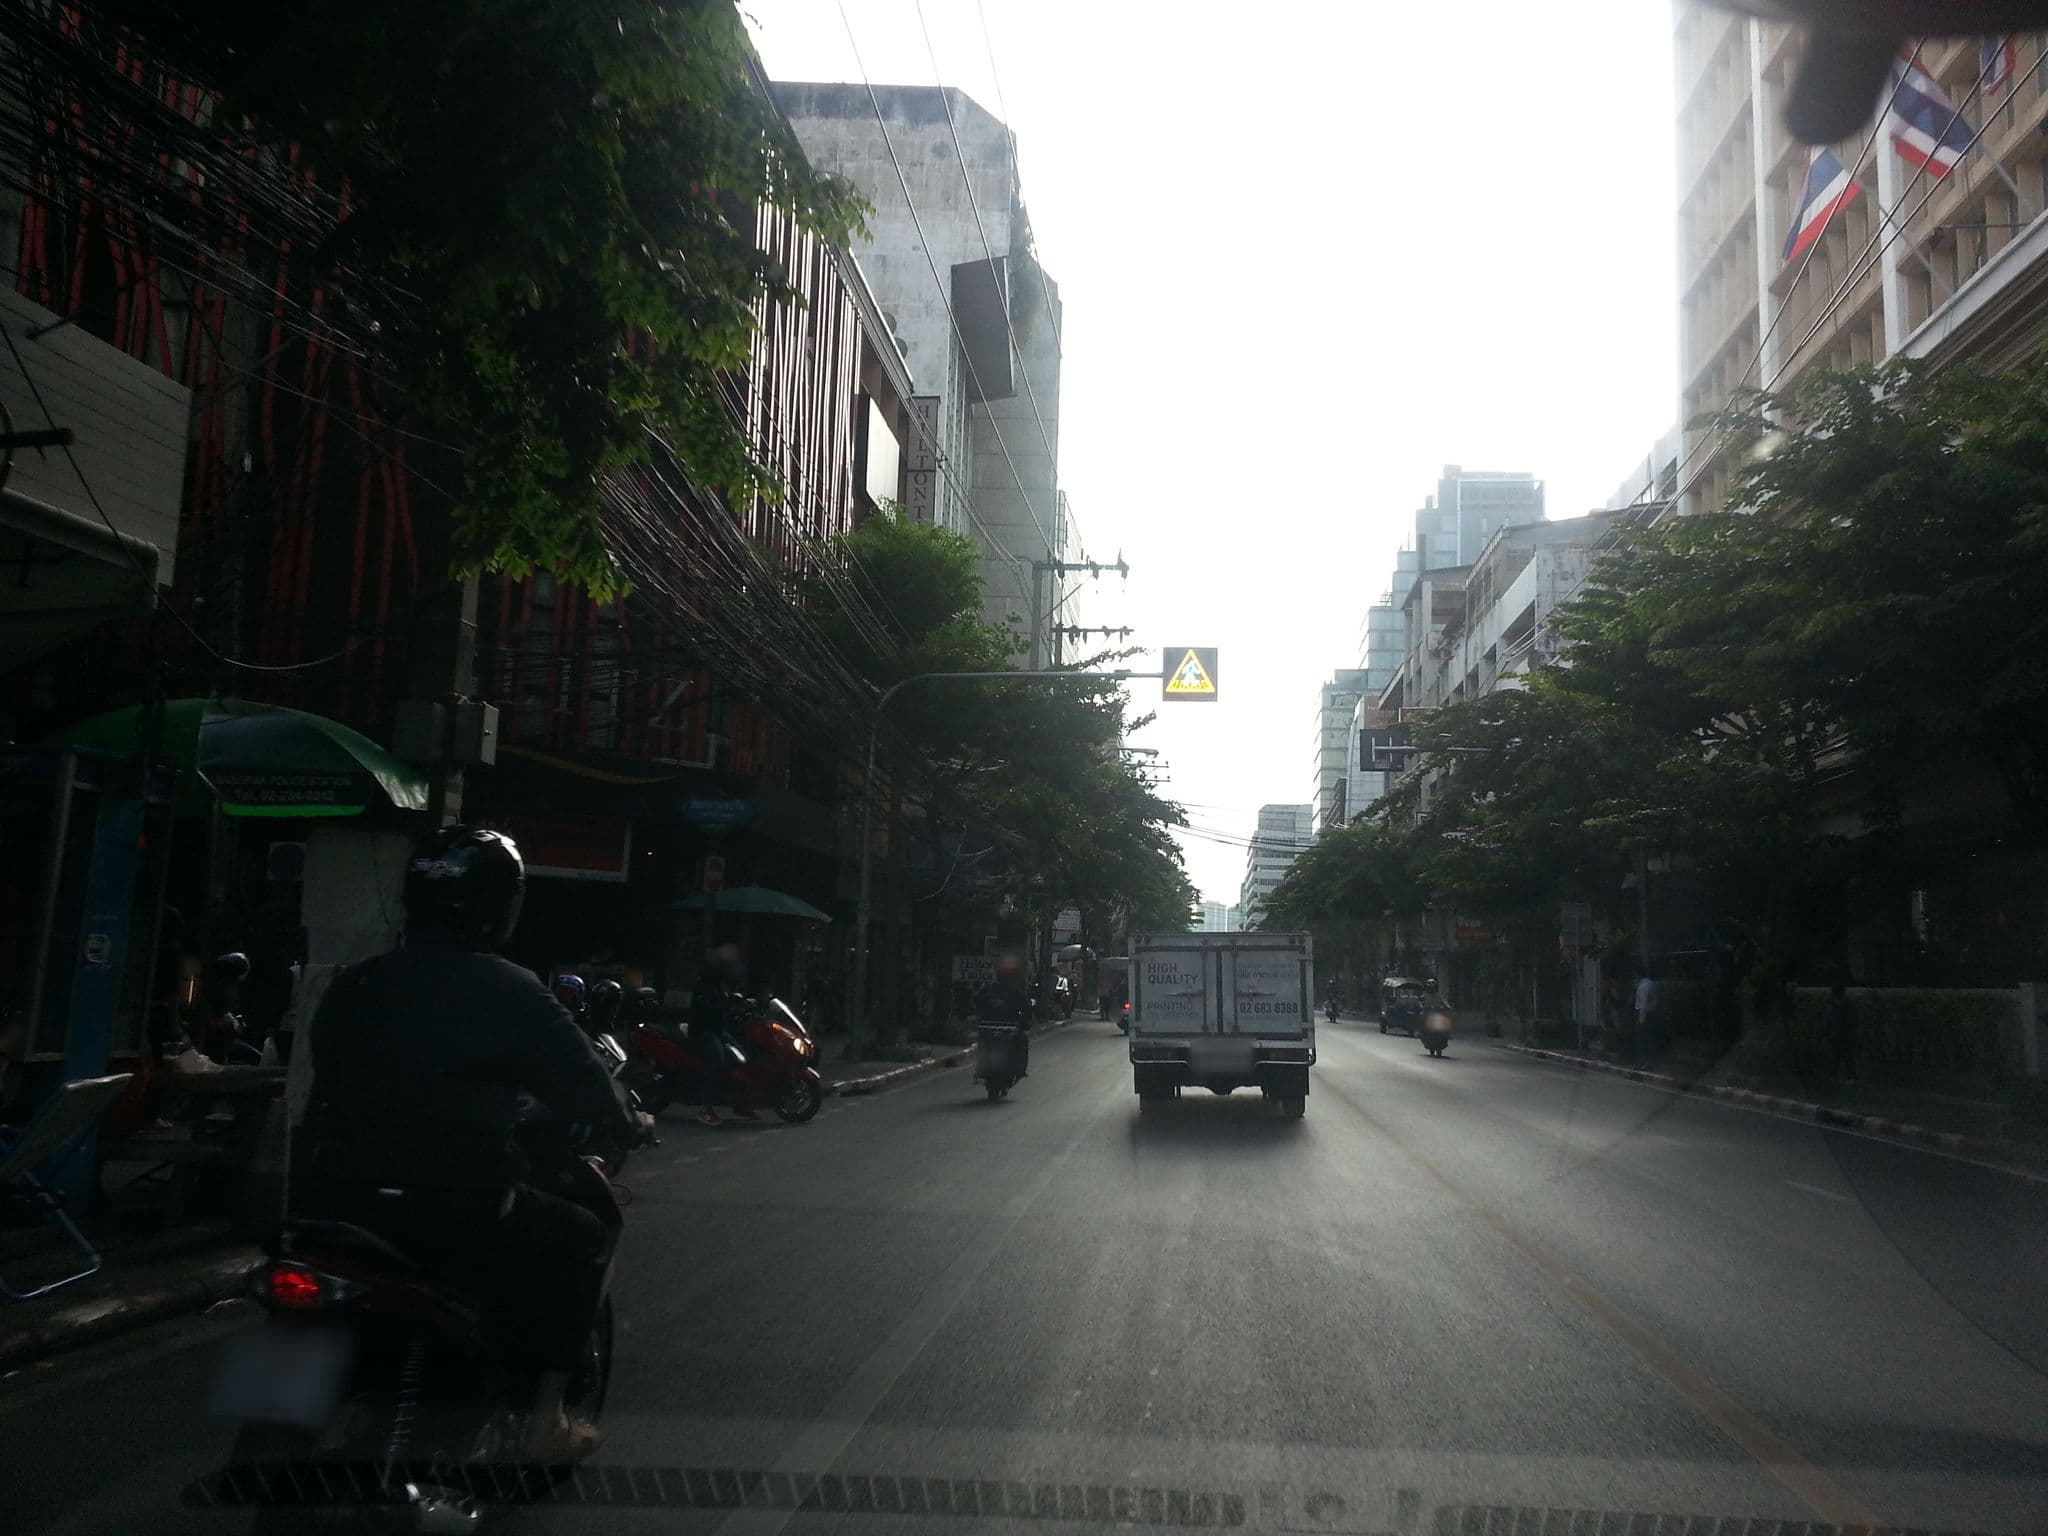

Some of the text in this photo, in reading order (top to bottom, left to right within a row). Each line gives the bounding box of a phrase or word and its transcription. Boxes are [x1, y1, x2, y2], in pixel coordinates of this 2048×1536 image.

[912, 405, 930, 502] HILTON
[271, 775, 306, 785] POLICE
[1148, 962, 1177, 973] HIGH
[1148, 974, 1198, 985] QUALITY
[1240, 1002, 1252, 1014] 02
